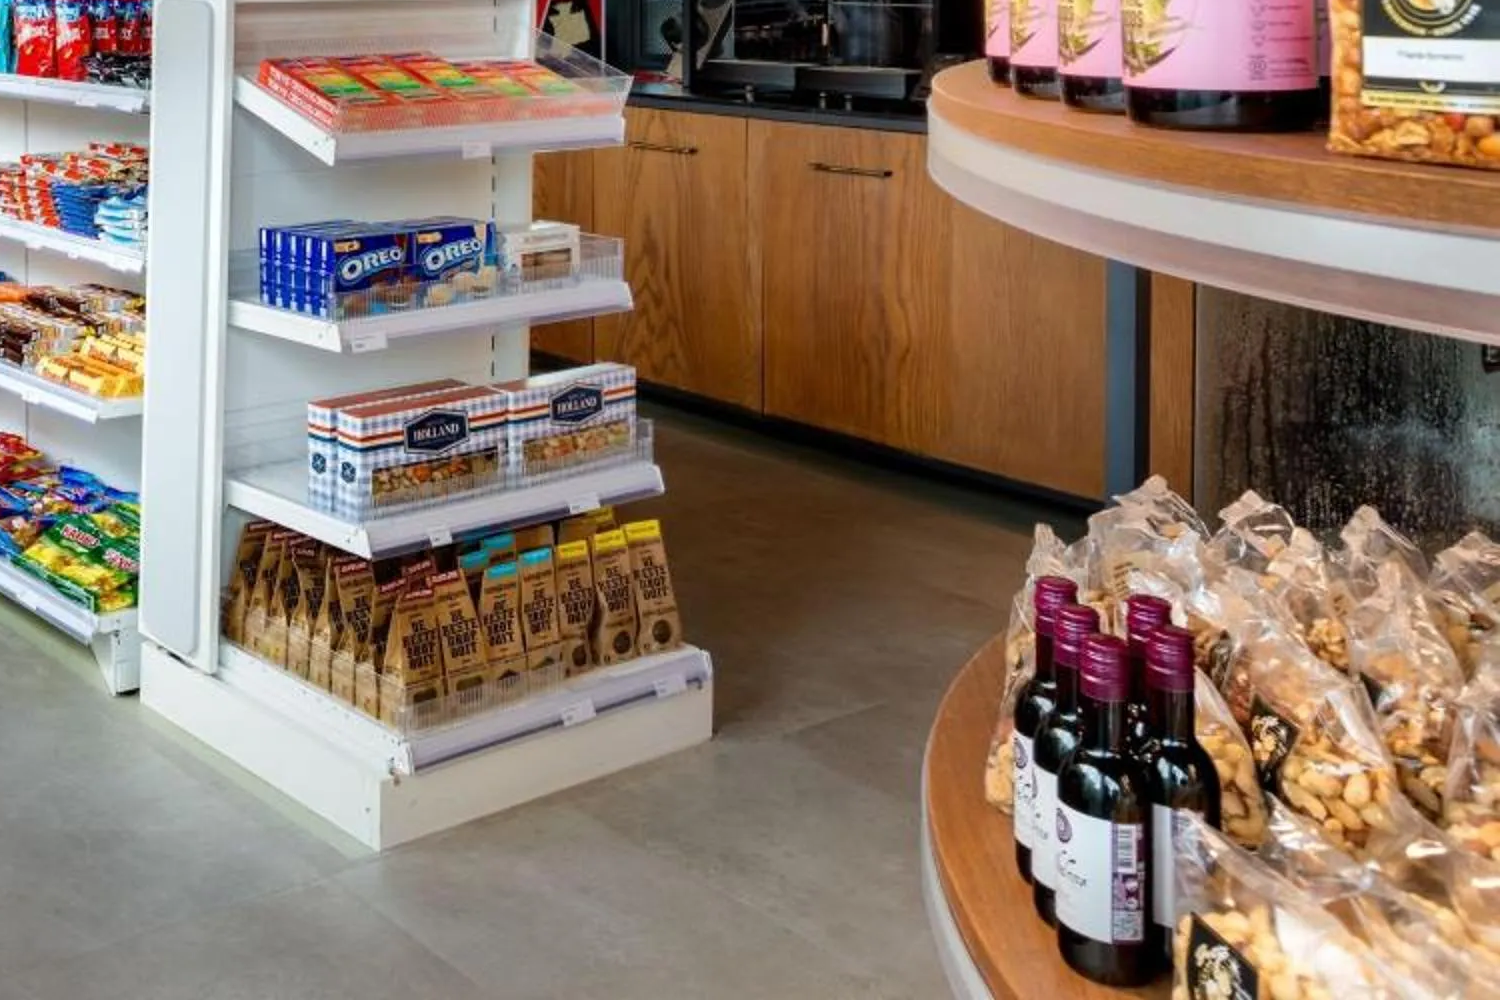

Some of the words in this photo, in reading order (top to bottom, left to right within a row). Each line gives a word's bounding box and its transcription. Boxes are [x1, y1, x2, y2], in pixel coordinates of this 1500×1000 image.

[341, 247, 403, 280] OREO
[425, 239, 483, 271] OREO
[557, 396, 598, 413] HOLLAND
[413, 423, 461, 442] HOLLAND
